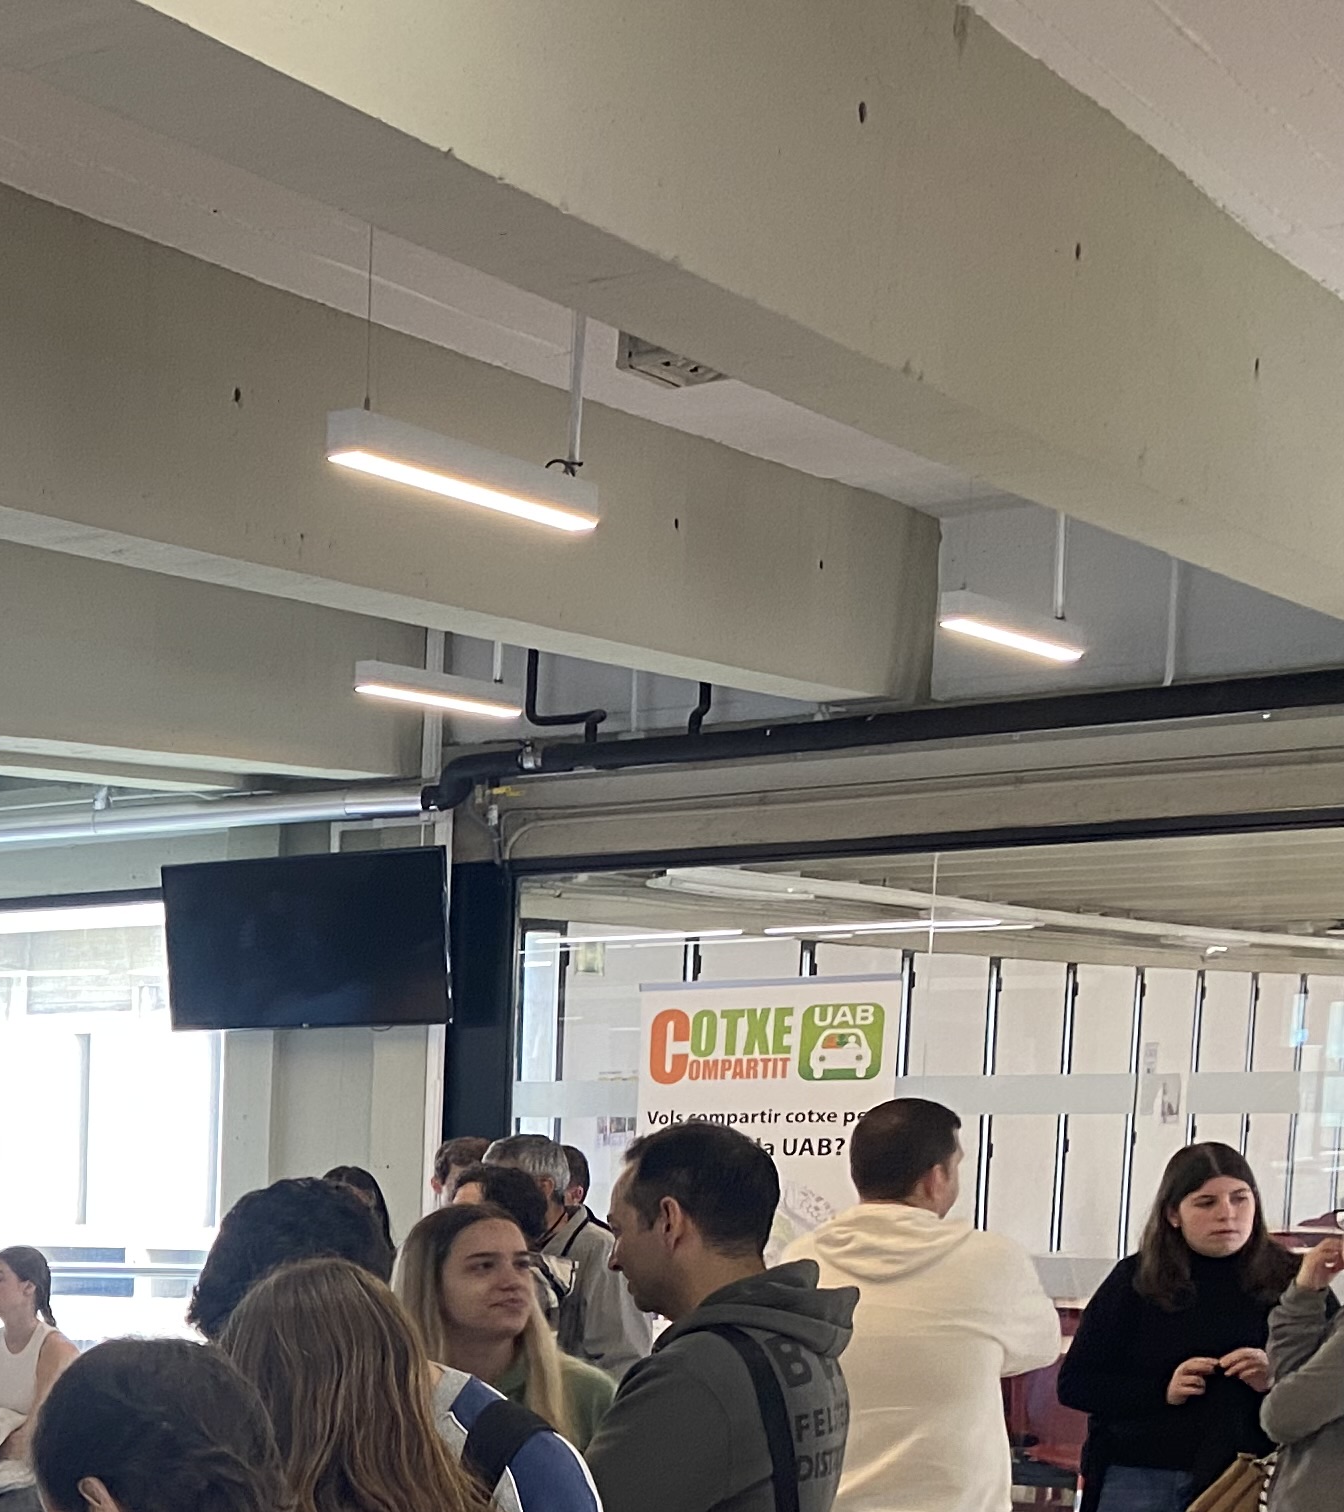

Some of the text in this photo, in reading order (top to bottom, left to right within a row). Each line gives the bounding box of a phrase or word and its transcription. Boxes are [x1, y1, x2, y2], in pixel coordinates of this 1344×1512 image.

[650, 1005, 874, 1084] COTXE UAB
[647, 1110, 683, 1125] Vols
[785, 1110, 838, 1123] cotxe
[783, 1138, 846, 1156] UAB?
